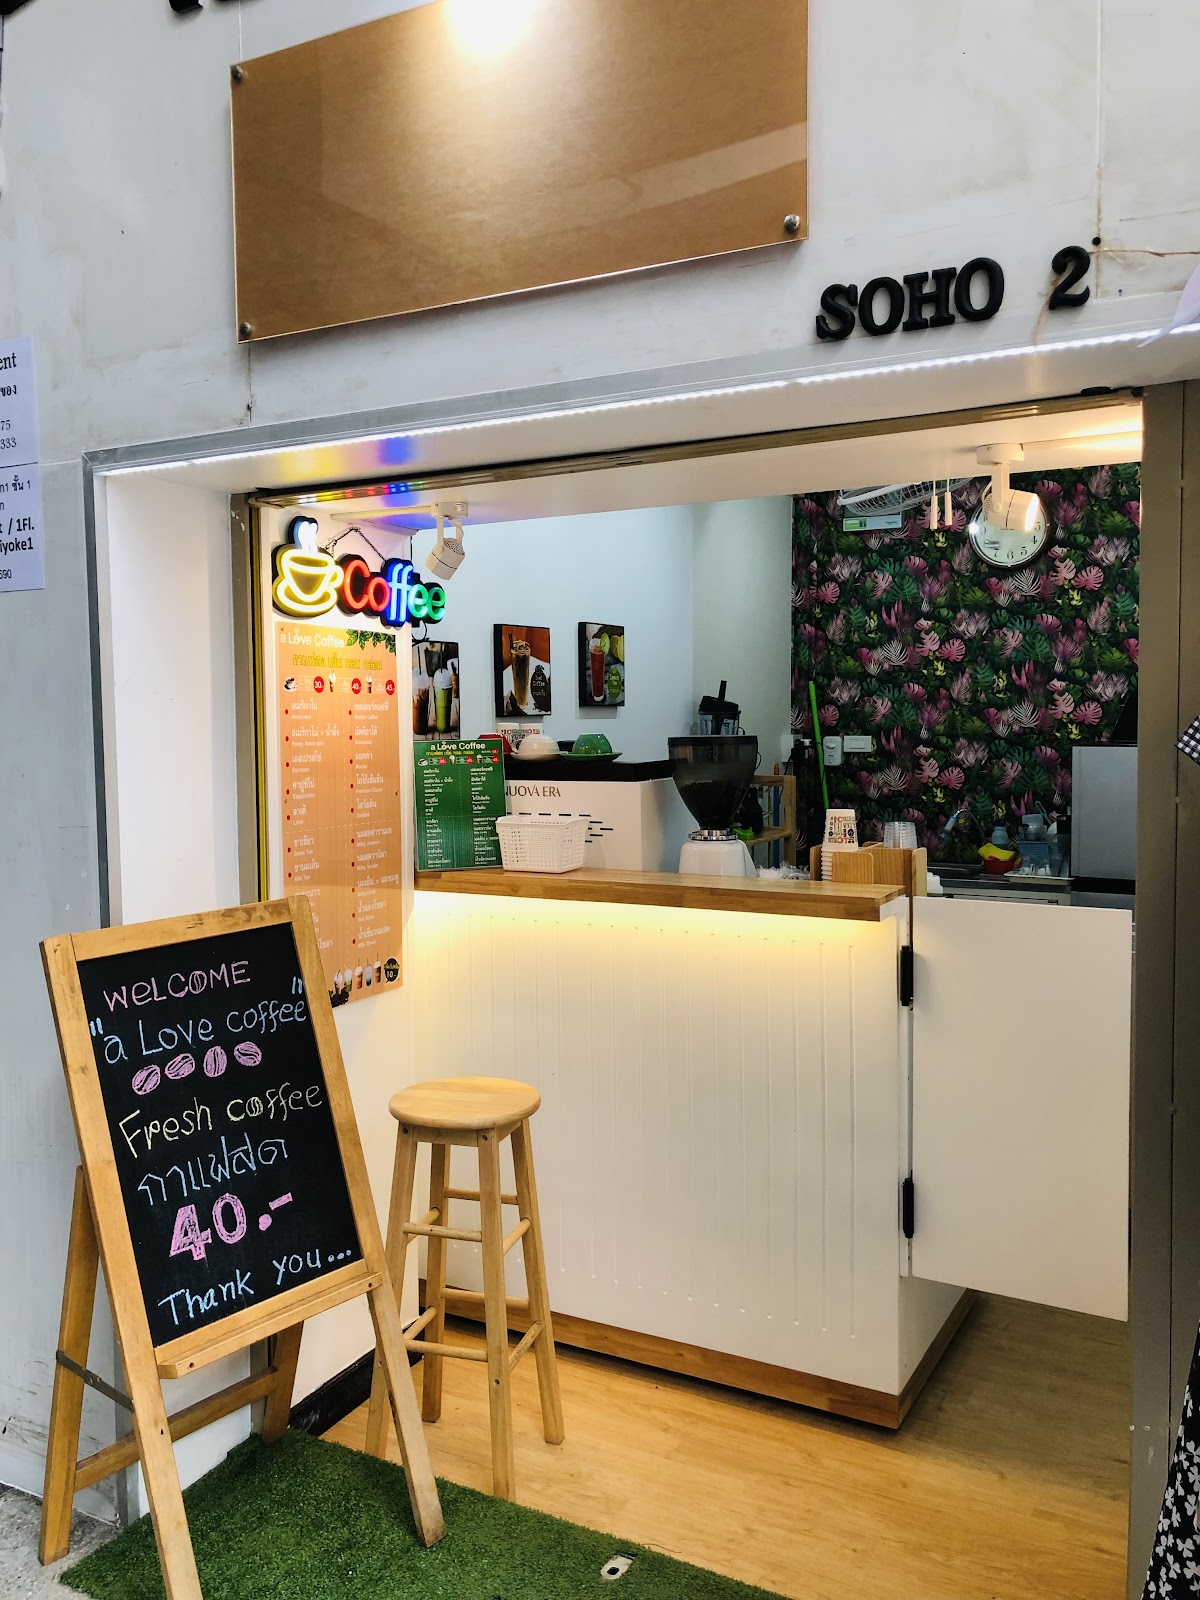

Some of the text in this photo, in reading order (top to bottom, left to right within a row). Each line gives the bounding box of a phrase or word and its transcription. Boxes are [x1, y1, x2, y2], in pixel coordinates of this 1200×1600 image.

[815, 244, 1091, 341] SOHO 2
[343, 559, 446, 622] Coffee
[280, 629, 345, 649] a Love Coffee
[437, 741, 457, 751] Love
[458, 742, 486, 750] Coffee
[542, 786, 561, 798] ERA
[138, 1016, 215, 1057] Love
[118, 1081, 323, 1159] Fresh coffee
[137, 1131, 289, 1206] กาแฟสด
[157, 1268, 255, 1326] Thank
